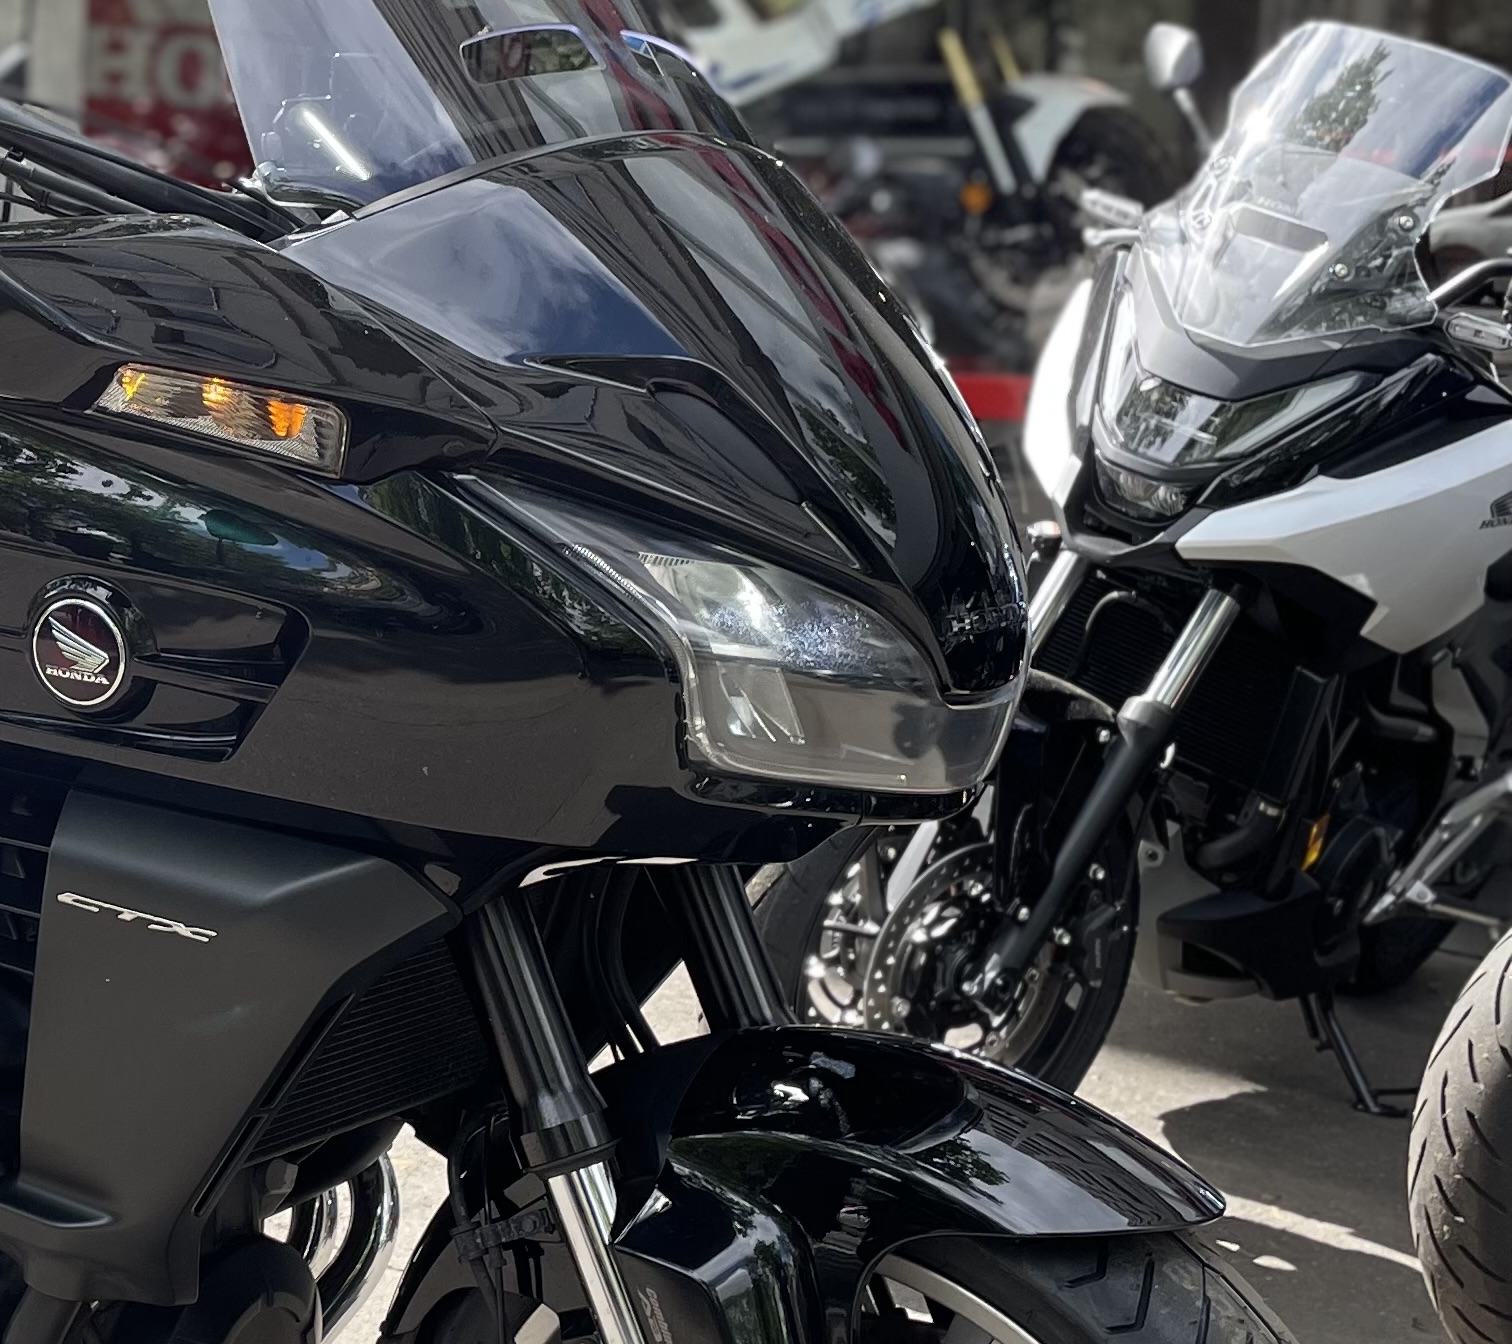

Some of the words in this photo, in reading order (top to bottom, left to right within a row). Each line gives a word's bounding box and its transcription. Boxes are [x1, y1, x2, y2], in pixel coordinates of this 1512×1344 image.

[86, 24, 234, 107] HO
[46, 665, 110, 685] HONDA
[57, 892, 218, 943] CTX
